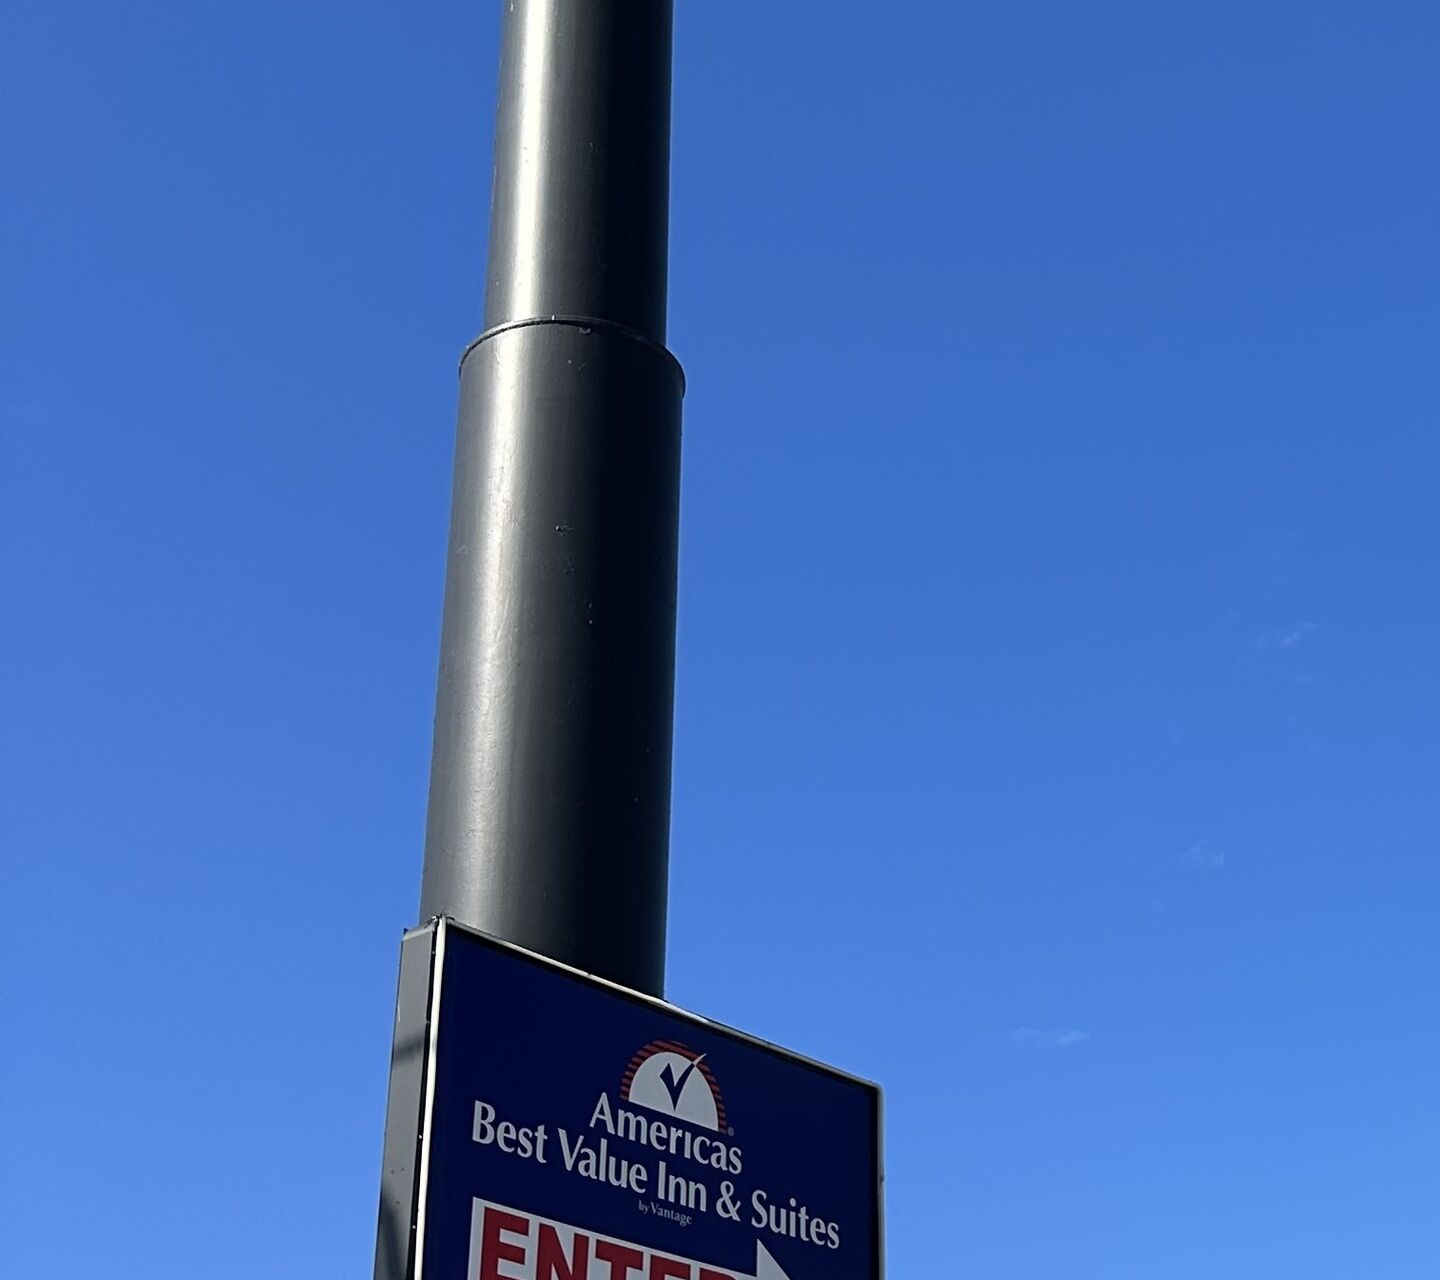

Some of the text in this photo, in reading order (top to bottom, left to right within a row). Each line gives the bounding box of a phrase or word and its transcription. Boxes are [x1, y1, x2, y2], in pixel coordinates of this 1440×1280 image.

[589, 1092, 742, 1174] Americas
[472, 1100, 840, 1250] Best Value Inn & Suites
[651, 1201, 692, 1227] Vantage
